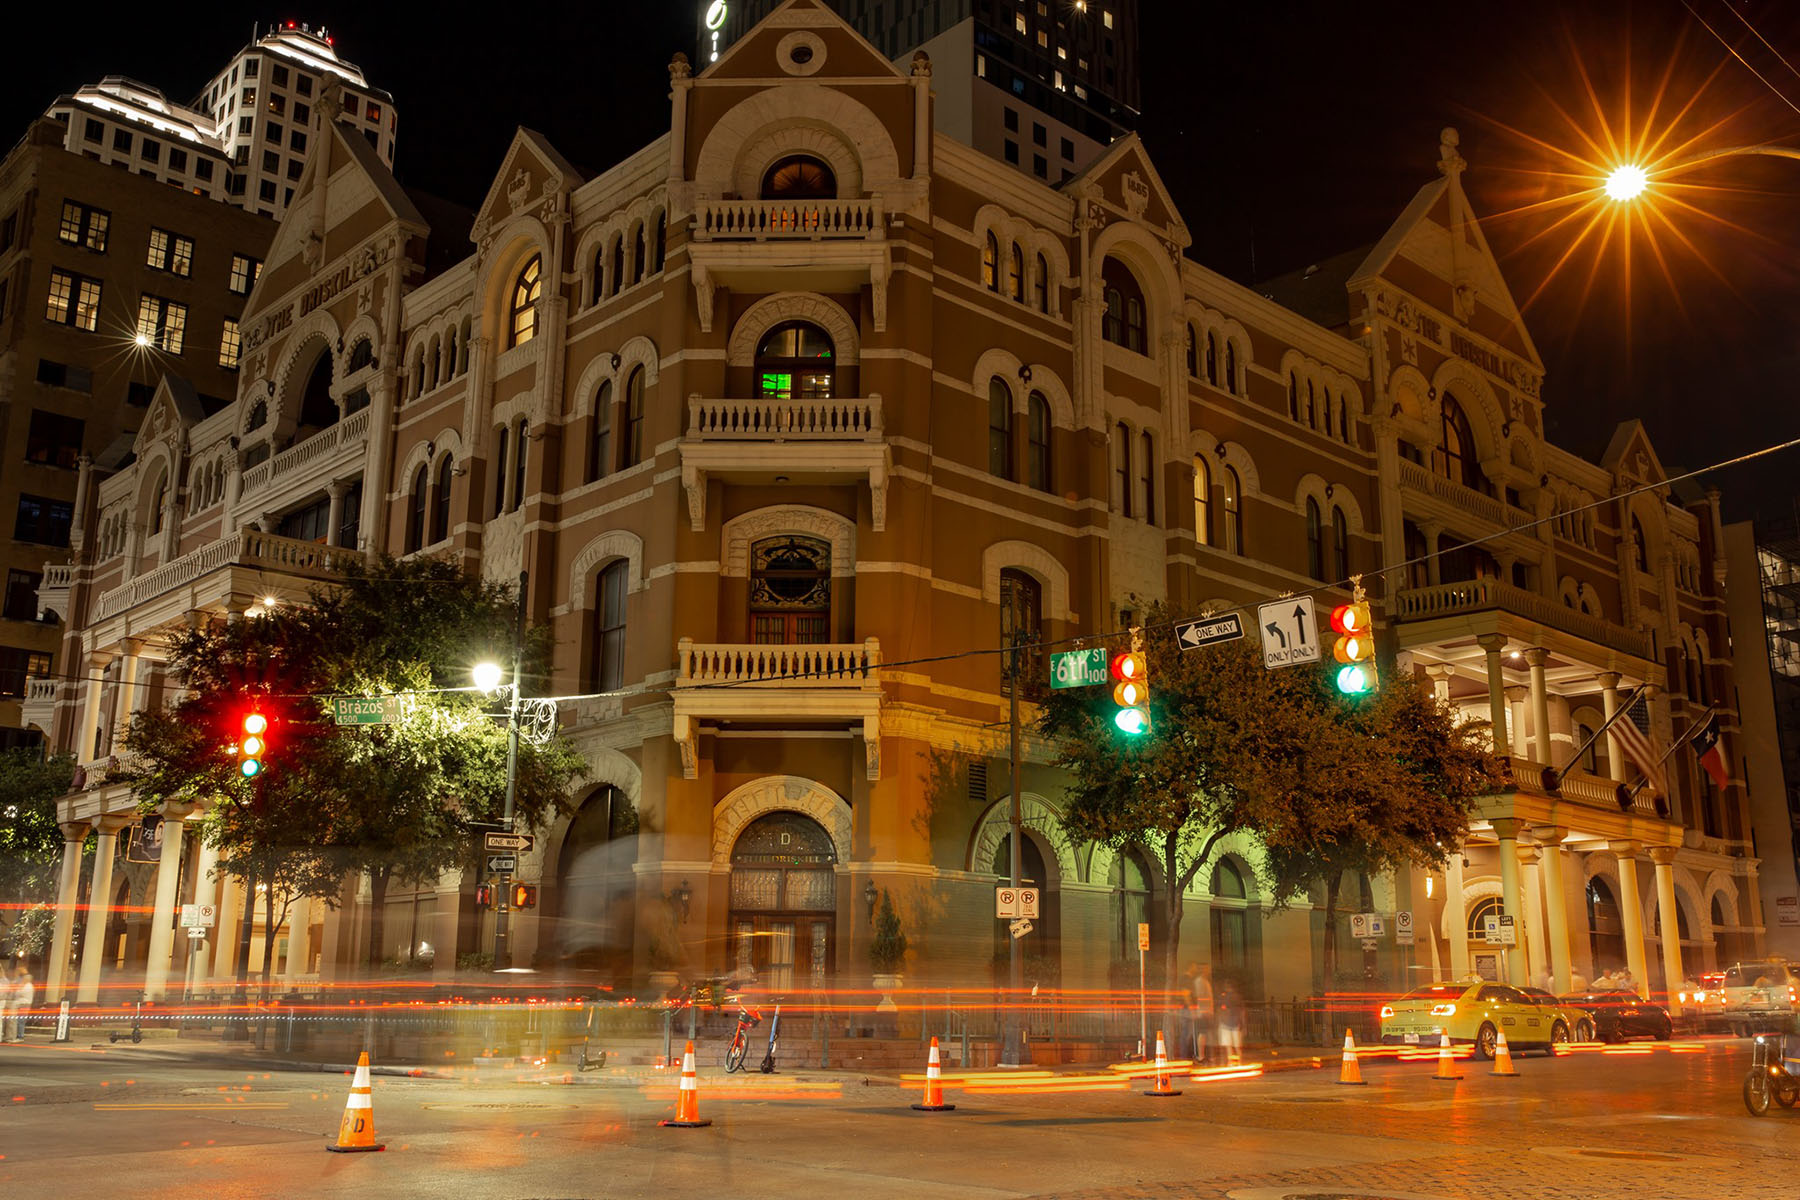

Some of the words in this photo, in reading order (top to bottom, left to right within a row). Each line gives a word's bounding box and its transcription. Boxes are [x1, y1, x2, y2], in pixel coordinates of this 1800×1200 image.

[1128, 177, 1148, 198] 1885
[270, 303, 294, 338] THE
[1417, 313, 1442, 346] THE
[1450, 332, 1516, 386] DRISKILL
[1196, 629, 1214, 639] ONE
[1215, 621, 1234, 634] WAY
[1267, 650, 1290, 663] ONLY
[1293, 646, 1316, 659] ONLY
[1056, 655, 1089, 682] 6th
[1092, 647, 1106, 662] ST
[1089, 668, 1107, 683] 100
[339, 700, 384, 714] Brazos
[386, 698, 396, 708] ST
[343, 715, 358, 723] 500
[781, 832, 791, 845] D
[771, 855, 822, 863] DRISKILL
